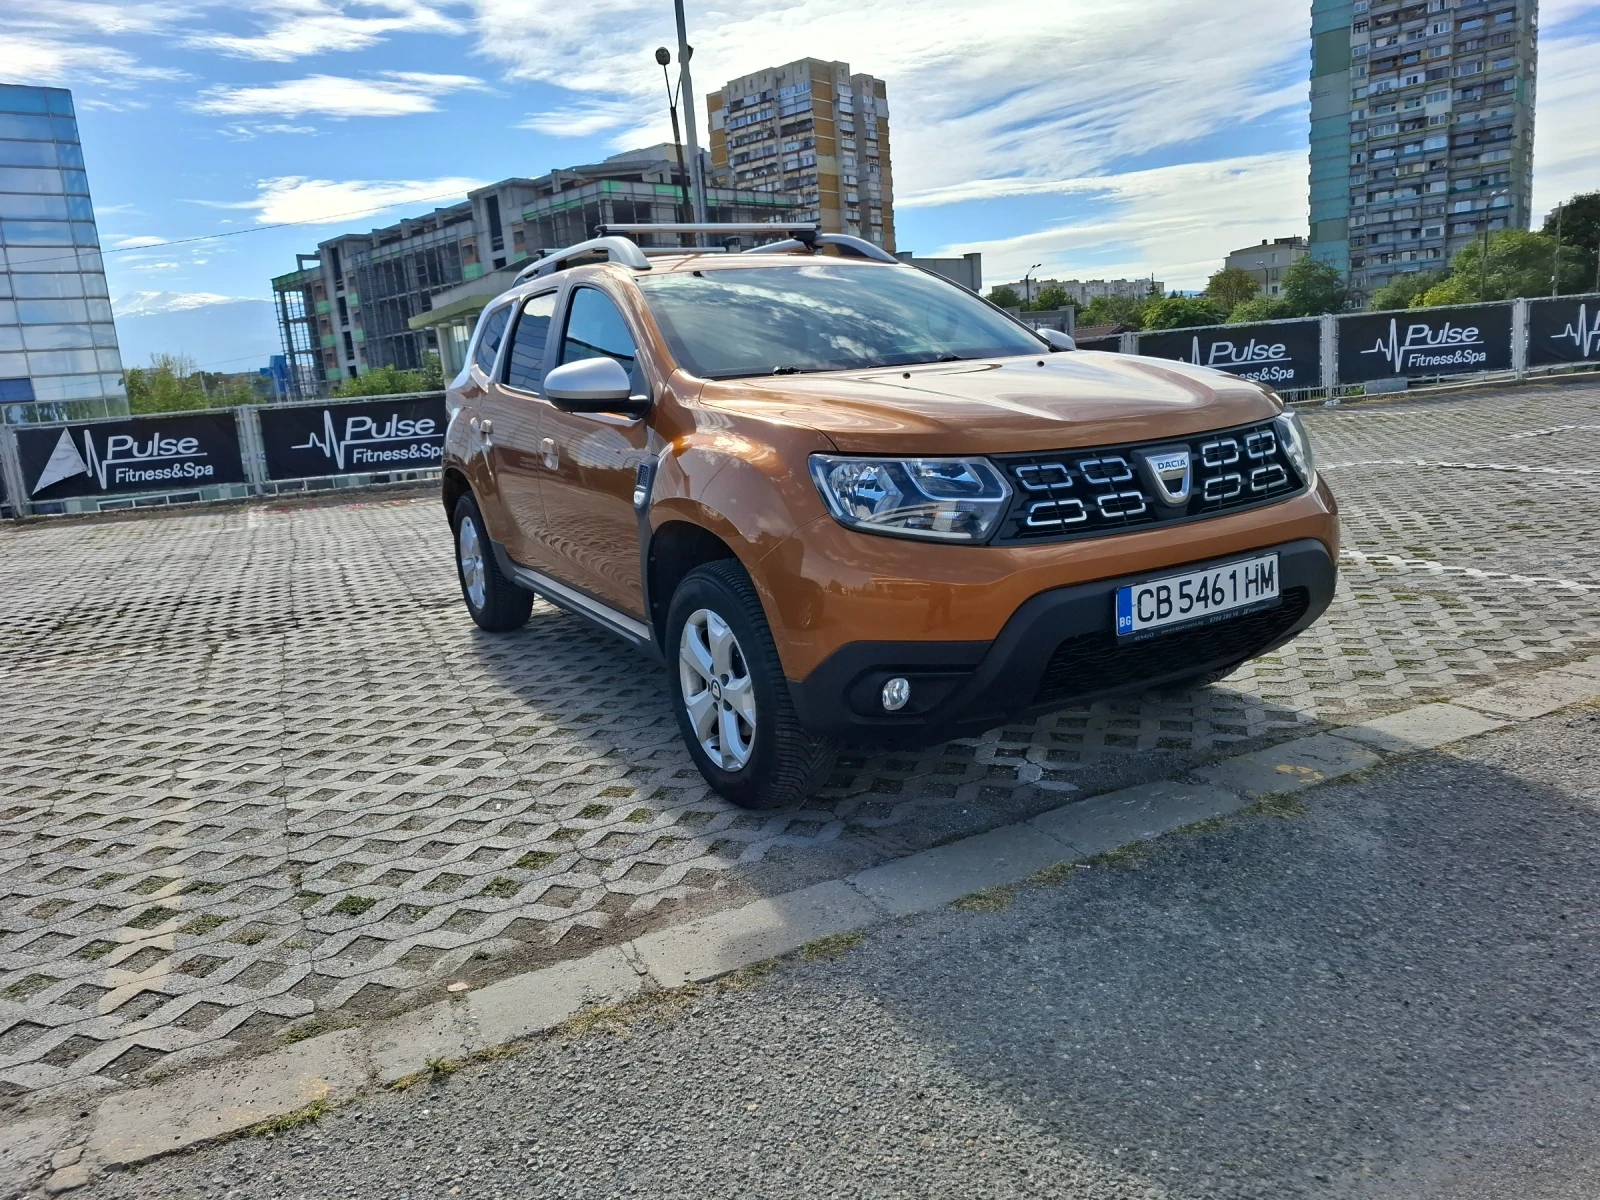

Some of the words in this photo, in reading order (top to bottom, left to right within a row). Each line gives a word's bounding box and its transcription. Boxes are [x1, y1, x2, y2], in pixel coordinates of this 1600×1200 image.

[1405, 322, 1479, 346] Pulse
[1208, 339, 1286, 364] Pulse
[1408, 350, 1487, 367] Fitness&Spa
[1237, 366, 1295, 382] ess&Spa
[345, 414, 436, 440] Pulse
[107, 432, 199, 460] Pulse
[115, 462, 214, 483] Fitness&Spa
[1157, 460, 1186, 470] DACIA
[1137, 585, 1173, 622] CB
[1179, 569, 1237, 613] 5461
[1245, 561, 1275, 598] HM
[1119, 616, 1132, 628] BG
